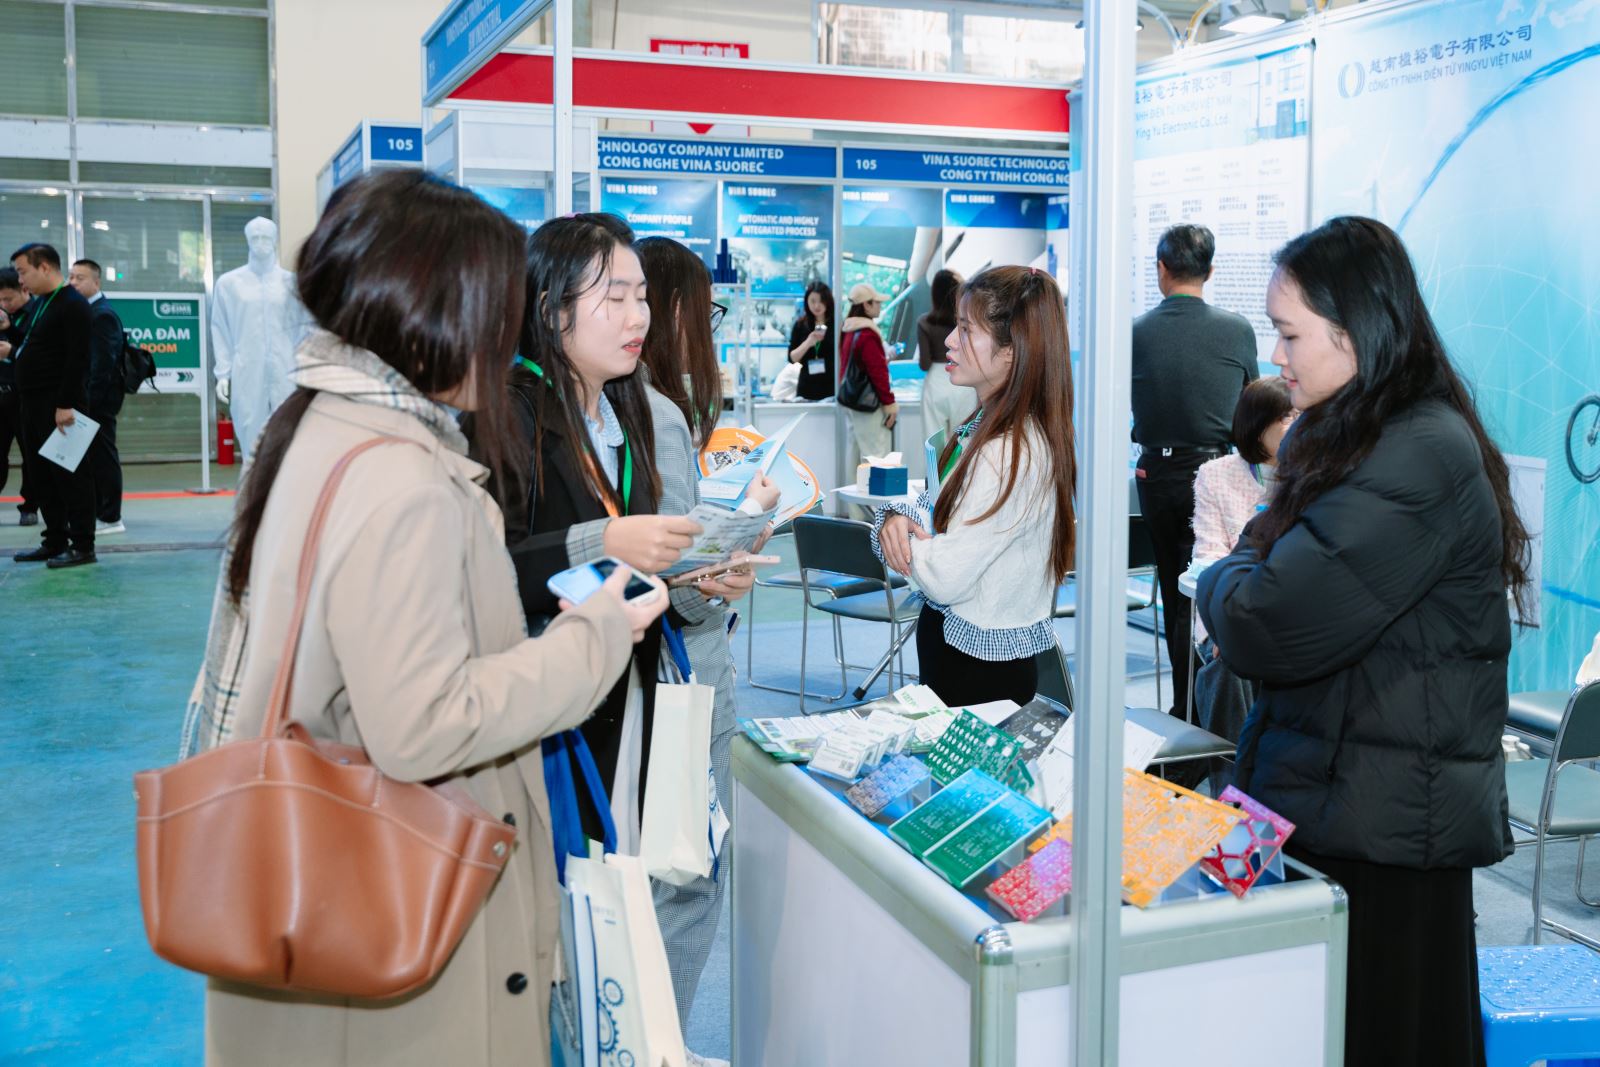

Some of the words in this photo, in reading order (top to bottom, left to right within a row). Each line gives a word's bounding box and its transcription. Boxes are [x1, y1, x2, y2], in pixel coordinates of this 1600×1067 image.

[1401, 72, 1422, 84] TNHH
[1458, 57, 1489, 73] YINGYU
[1512, 48, 1532, 63] NAM
[387, 139, 414, 151] 105
[668, 144, 731, 157] COMPANY
[733, 147, 784, 159] LIMITED
[603, 156, 641, 168] CONG
[643, 158, 679, 169] NGHE
[681, 159, 712, 171] VINA
[715, 160, 764, 173] SUOREC
[855, 159, 877, 170] 105
[922, 154, 951, 166] VINA
[953, 155, 997, 168] SUOREC
[941, 169, 973, 181] CONG
[974, 170, 988, 181] TY
[990, 171, 1021, 182] TNHH
[1022, 172, 1054, 184] CONG
[627, 213, 661, 224] COMPANY
[662, 214, 693, 225] PROFILE
[738, 214, 778, 224] AUTOMATIC
[779, 215, 793, 225] AND
[793, 216, 819, 226] HIGHLY
[742, 225, 785, 235] INTEGRATED
[785, 226, 816, 237] PROCESS
[156, 325, 190, 340] ĐÀM
